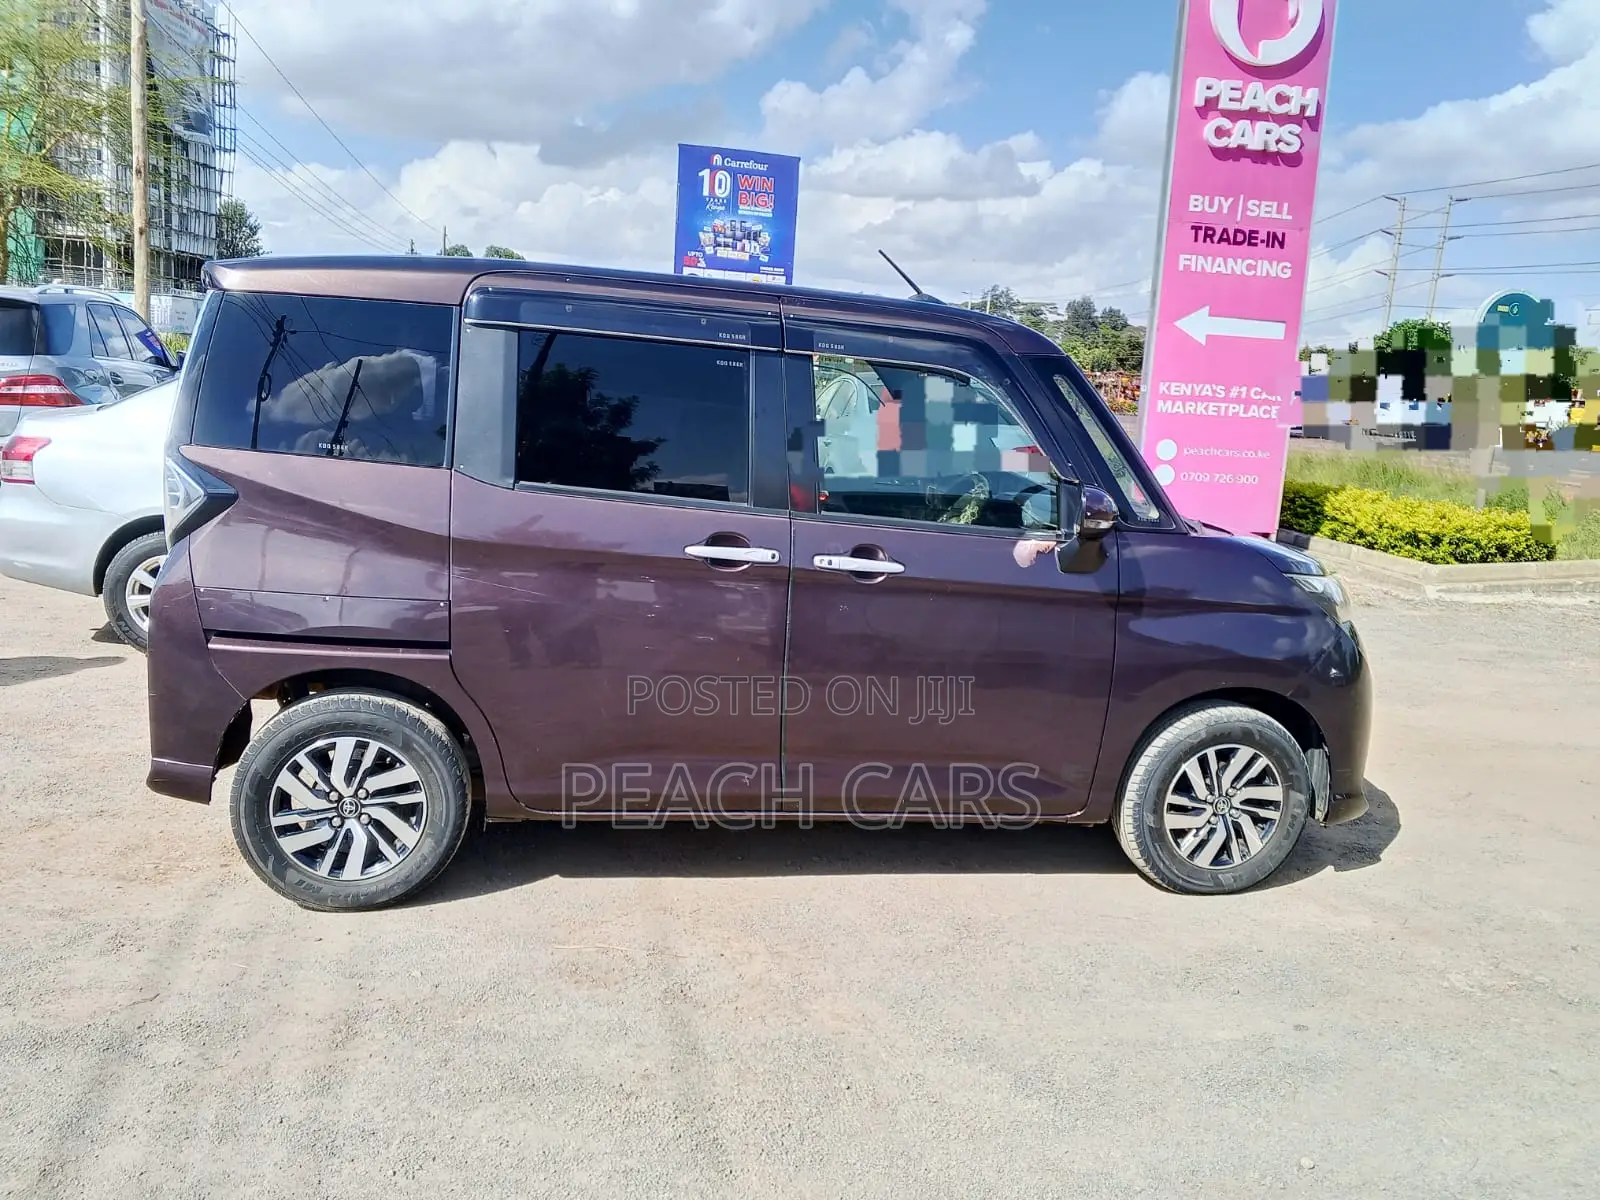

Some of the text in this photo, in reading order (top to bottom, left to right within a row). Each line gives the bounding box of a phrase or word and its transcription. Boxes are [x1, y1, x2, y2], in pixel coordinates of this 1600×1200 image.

[1194, 76, 1319, 117] PEACH
[1203, 117, 1302, 154] CARS
[723, 157, 769, 171] Carrefour
[698, 168, 731, 198] 10
[737, 173, 775, 193] WIN
[737, 190, 775, 209] BIG!
[1188, 194, 1293, 220] BUY SELL
[1190, 225, 1286, 250] TRADE-IN
[1178, 254, 1293, 279] FINANCING
[1159, 381, 1226, 398] KENYA'S
[1229, 386, 1248, 399] #1
[1156, 399, 1281, 419] MARKETPLACE
